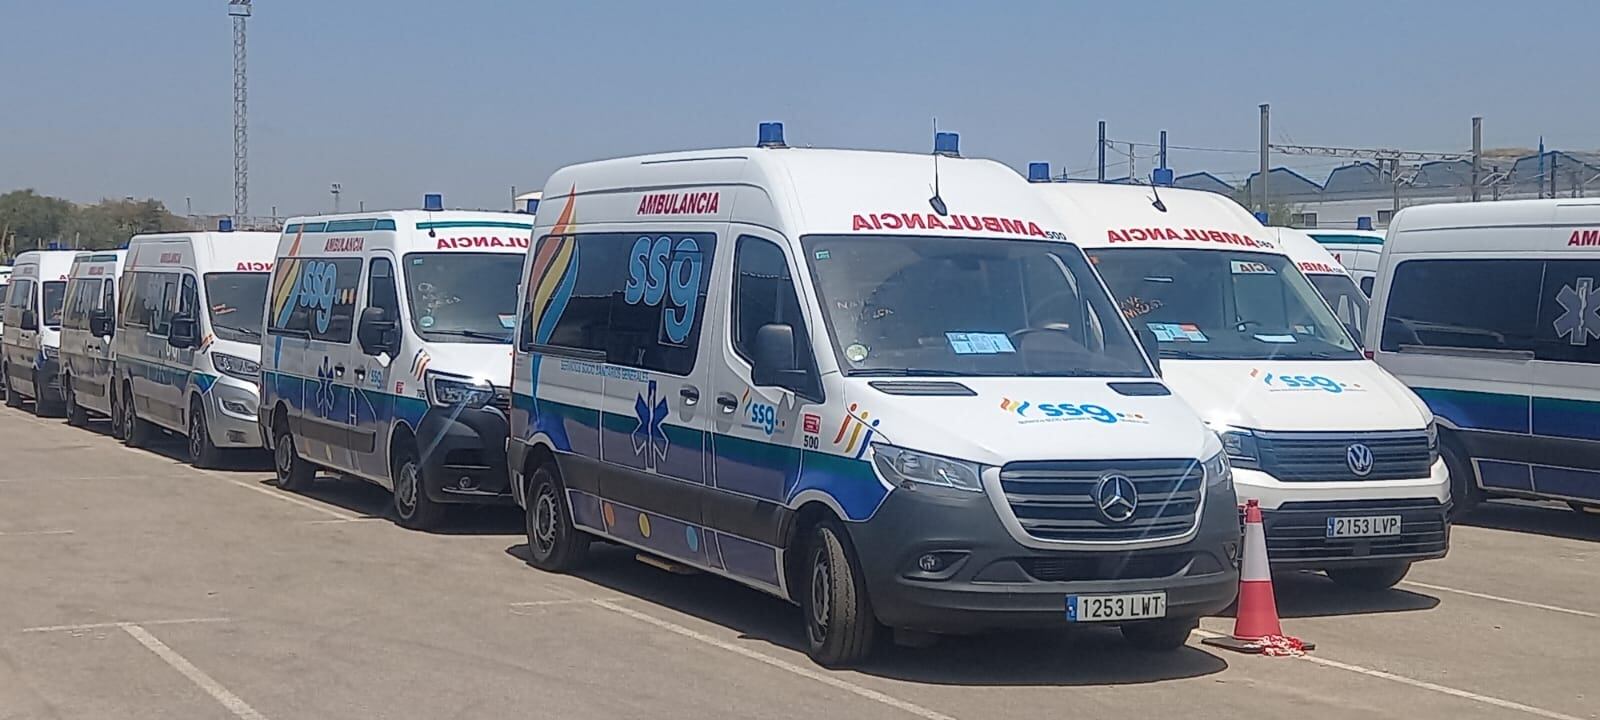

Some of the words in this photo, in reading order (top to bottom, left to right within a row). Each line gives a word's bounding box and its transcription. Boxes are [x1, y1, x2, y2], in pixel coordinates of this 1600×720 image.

[637, 192, 720, 214] AMBULANCIA
[324, 237, 365, 251] AMBULANCIA
[1567, 229, 1600, 246] AM
[300, 260, 337, 334] ssg
[624, 236, 703, 344] ssg
[1279, 375, 1342, 393] ssg
[751, 402, 775, 436] ssg
[1038, 403, 1118, 424] ssg
[803, 435, 819, 450] 500
[1336, 518, 1370, 535] 2153
[1373, 517, 1398, 534] LVP
[1083, 598, 1125, 618] 1253
[1130, 596, 1161, 616] LWT
